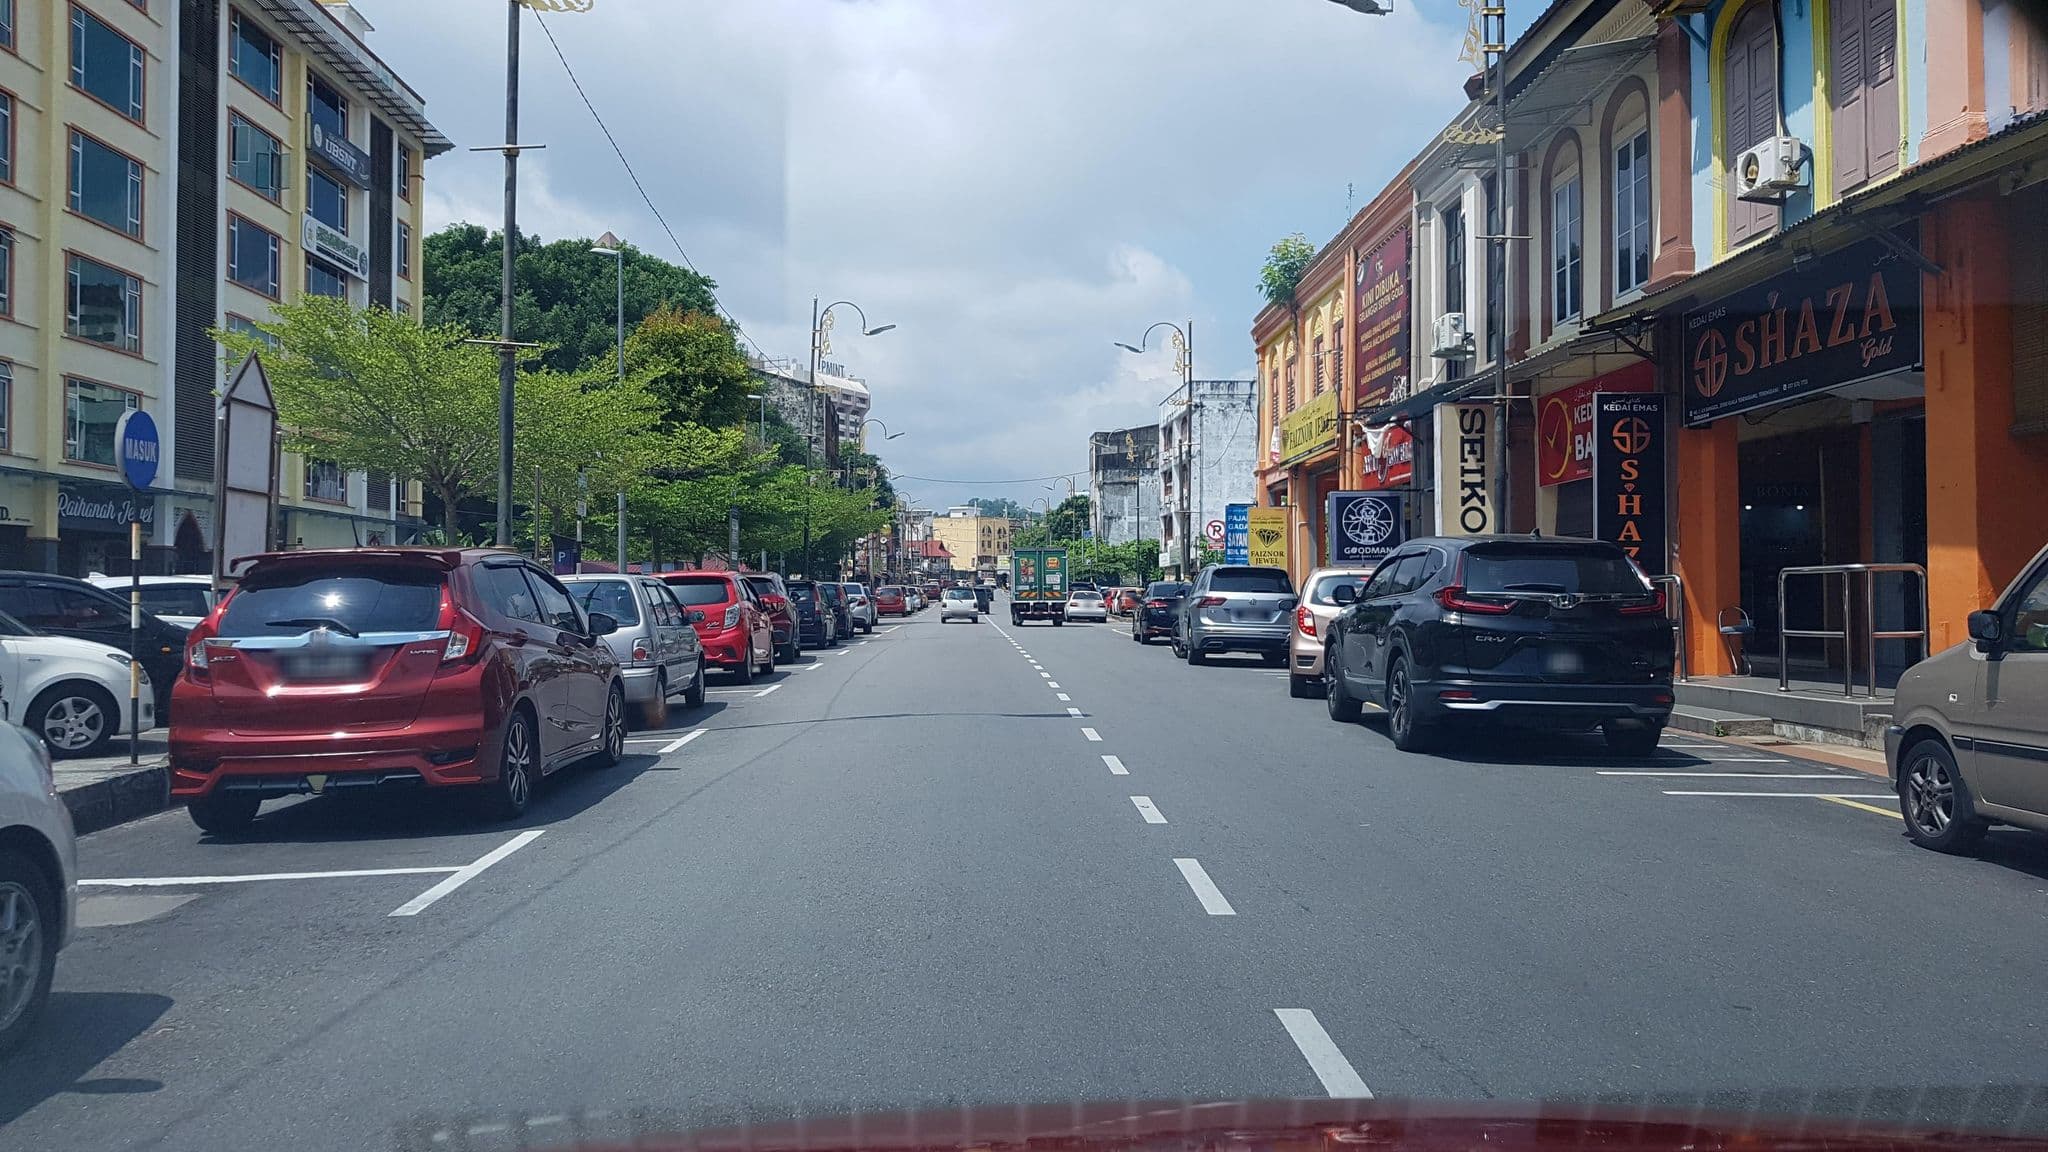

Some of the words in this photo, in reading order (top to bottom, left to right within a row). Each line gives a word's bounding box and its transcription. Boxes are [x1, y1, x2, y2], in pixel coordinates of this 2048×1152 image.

[325, 138, 357, 170] UBSNT
[1361, 287, 1375, 310] KINI
[1375, 269, 1400, 300] DIBUKA
[1390, 284, 1404, 301] GOLD
[1689, 314, 1707, 329] KEDAI
[1708, 306, 1726, 322] EMAS
[1733, 271, 1897, 376] SHAZA
[1860, 336, 1893, 368] Gold
[821, 360, 845, 377] PMINT
[1573, 402, 1593, 425] KED
[1603, 403, 1631, 412] KEDAI
[1632, 404, 1658, 412] EMAS
[1289, 421, 1313, 450] FAIZNOR
[1574, 431, 1594, 461] BA
[125, 438, 157, 462] MASUK
[1460, 408, 1487, 533] SEIKO
[58, 492, 116, 519] Raihanah
[1617, 459, 1642, 561] SHAZ
[1227, 532, 1248, 547] SAYAN
[1343, 546, 1393, 554] GOODMAN
[558, 551, 566, 563] P
